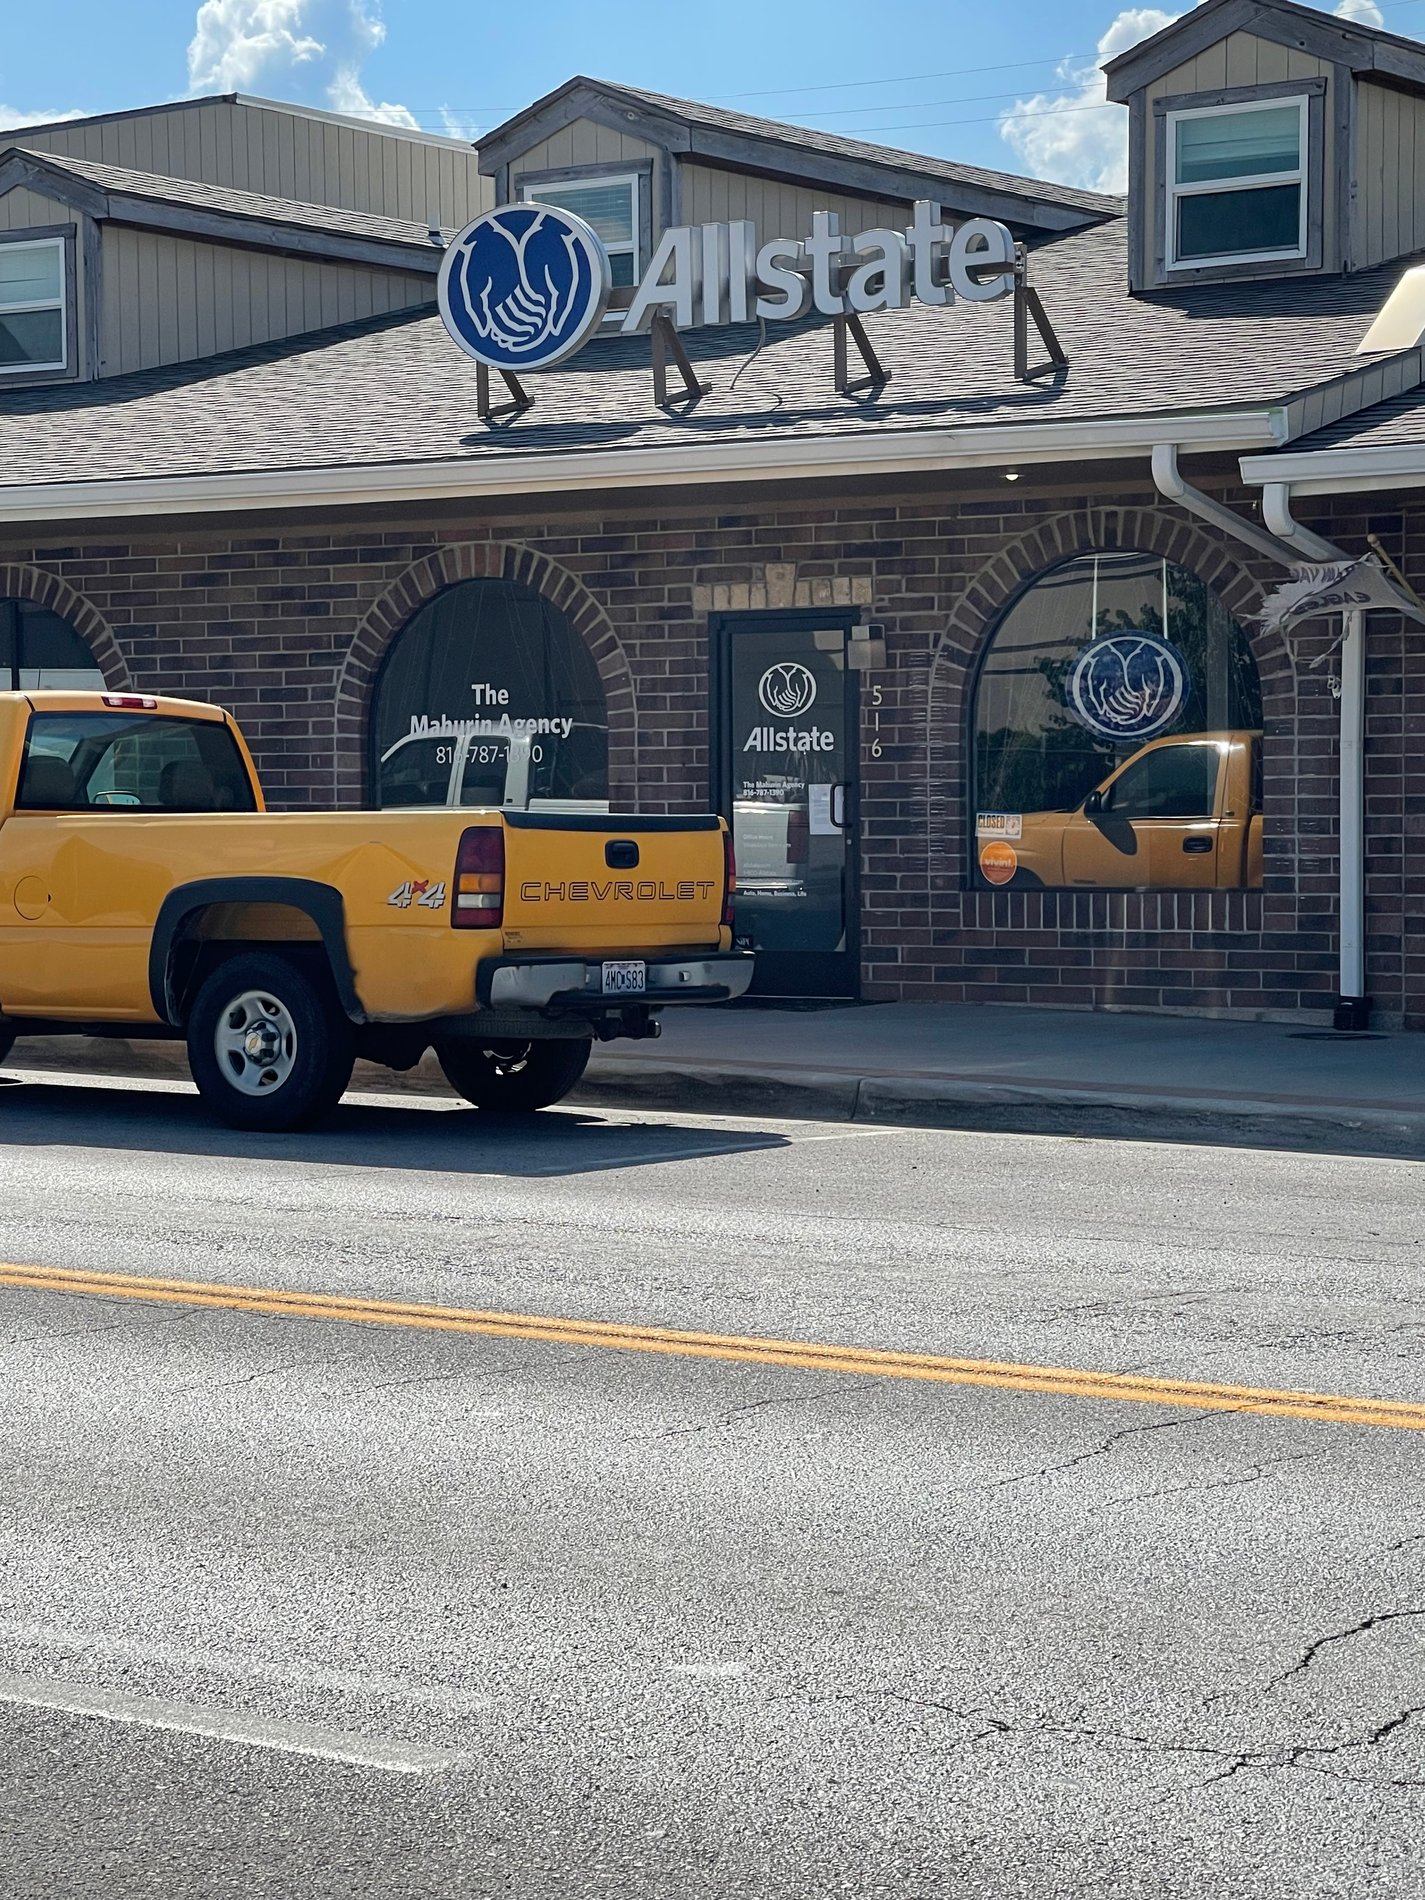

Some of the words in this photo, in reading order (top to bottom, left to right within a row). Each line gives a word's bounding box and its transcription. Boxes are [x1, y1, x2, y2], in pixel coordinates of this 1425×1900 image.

[621, 199, 1015, 332] Allstate
[471, 683, 509, 705] The
[410, 714, 492, 735] Mahurin
[500, 713, 573, 738] Agency
[743, 726, 834, 752] Allstate
[782, 781, 805, 790] Agency
[978, 814, 1005, 829] CLOSED
[521, 881, 715, 902] CHEVROLET
[626, 970, 644, 989] S83
